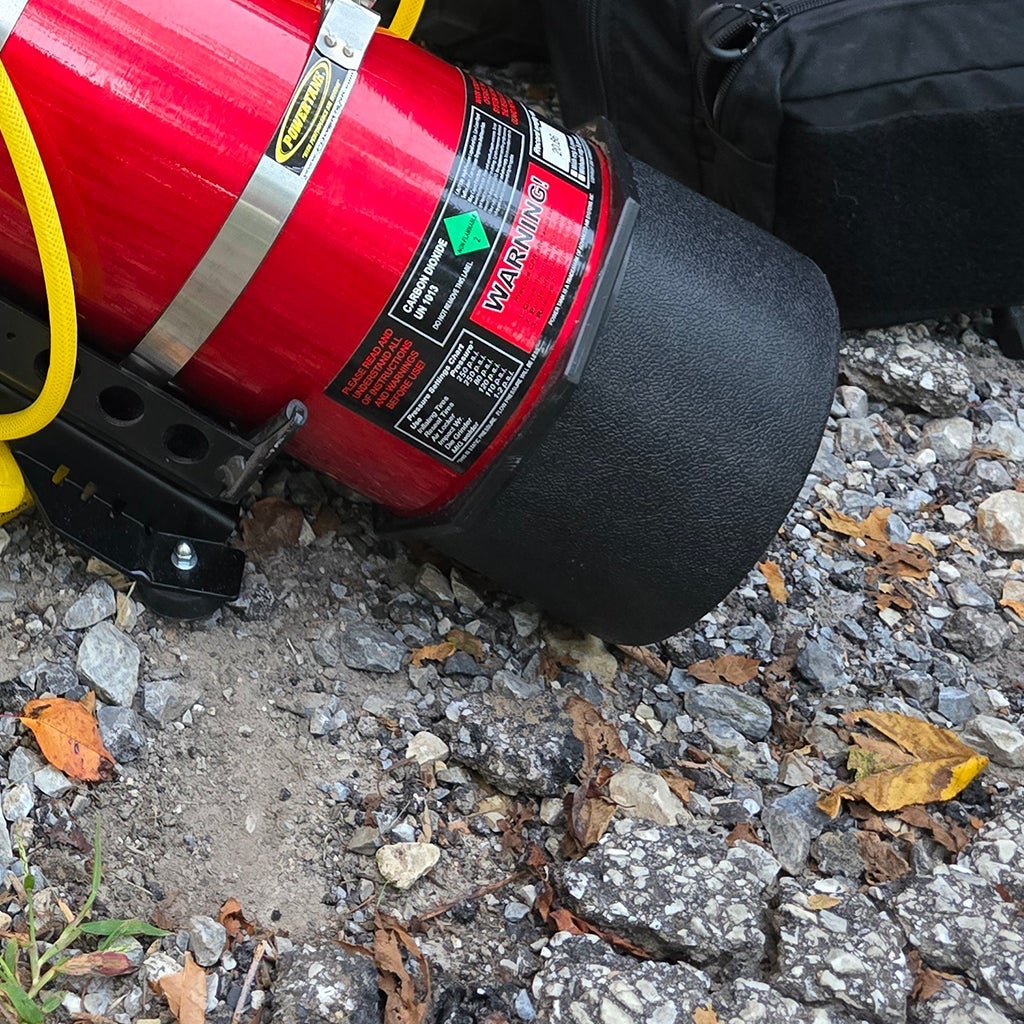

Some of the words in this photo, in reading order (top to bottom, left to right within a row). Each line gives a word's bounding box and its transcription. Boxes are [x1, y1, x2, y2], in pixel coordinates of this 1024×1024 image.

[482, 177, 550, 314] WARNING!
[401, 273, 429, 314] CARBON
[422, 237, 448, 276] DIOXIDE
[413, 304, 428, 321] UN
[421, 283, 439, 306] 1013
[431, 319, 441, 330] DO
[436, 308, 448, 321] NOT
[442, 287, 460, 310] REMOVE
[454, 276, 465, 289] THIS
[341, 367, 366, 395] PLEASE
[362, 345, 382, 368] READ
[377, 327, 394, 347] AND
[352, 350, 392, 399] UNDERSTAND
[387, 334, 402, 352] ALL
[361, 394, 373, 405] OF
[368, 338, 413, 395] INSTRUCTIONS
[373, 390, 390, 407] AND
[385, 349, 419, 392] WARNINGS
[386, 379, 413, 410] BEFORE
[408, 359, 426, 380] USE!
[405, 393, 431, 421] Pressure
[427, 364, 452, 393] Settings
[446, 342, 464, 364] Chart
[434, 395, 449, 411] Tires
[455, 366, 469, 382] 250
[439, 401, 454, 417] Tires
[463, 370, 476, 386] 250
[443, 438, 455, 450] Die
[451, 416, 473, 440] Grinder
[484, 383, 496, 397] 110
[409, 416, 423, 429] Use
[430, 432, 440, 442] Air
[436, 411, 456, 434] Locker
[461, 420, 480, 442] welder
